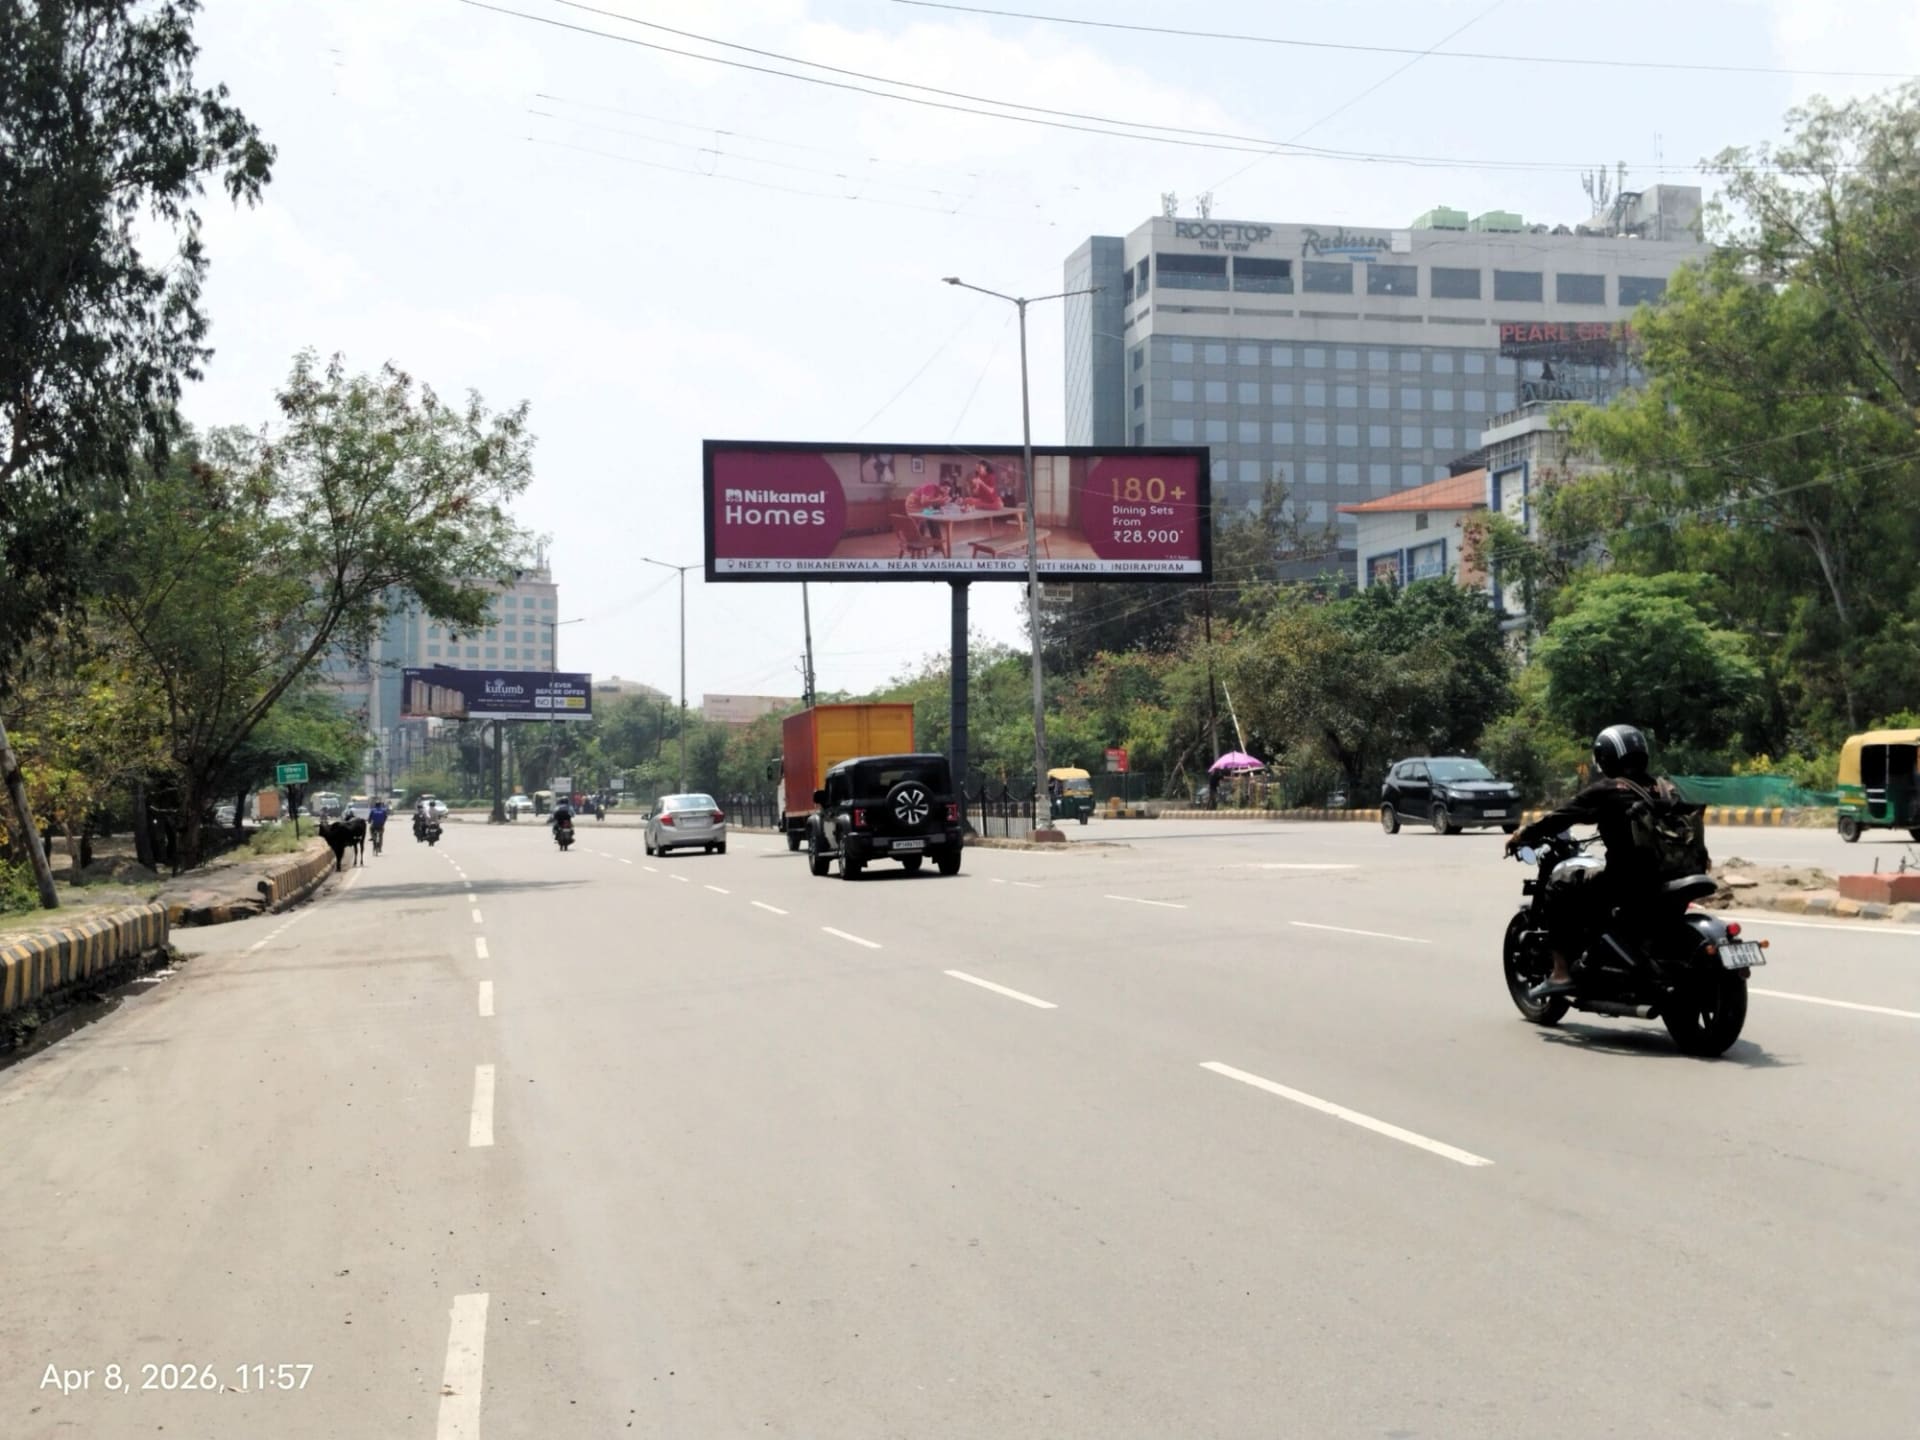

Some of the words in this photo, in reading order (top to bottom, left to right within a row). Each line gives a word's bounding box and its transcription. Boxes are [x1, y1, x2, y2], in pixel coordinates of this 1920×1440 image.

[1175, 222, 1273, 242] ROOFTOP
[1199, 240, 1220, 250] THE
[1223, 242, 1250, 252] VIEW
[1301, 226, 1391, 259] Radisson
[1501, 323, 1570, 341] PEARL
[743, 490, 826, 504] Nilkamal
[1111, 477, 1187, 503] 180+
[725, 505, 826, 525] Homes
[1112, 505, 1147, 517] Dining
[1150, 505, 1174, 516] Sets
[1112, 517, 1141, 526] From
[738, 560, 770, 570] NEXT
[776, 560, 792, 570] TO
[887, 561, 918, 570] NEAR
[922, 561, 973, 570] VAISHALI
[977, 561, 1016, 570] METRO
[1059, 562, 1097, 571] KHAND
[1111, 562, 1185, 572] INDIRAPURAM
